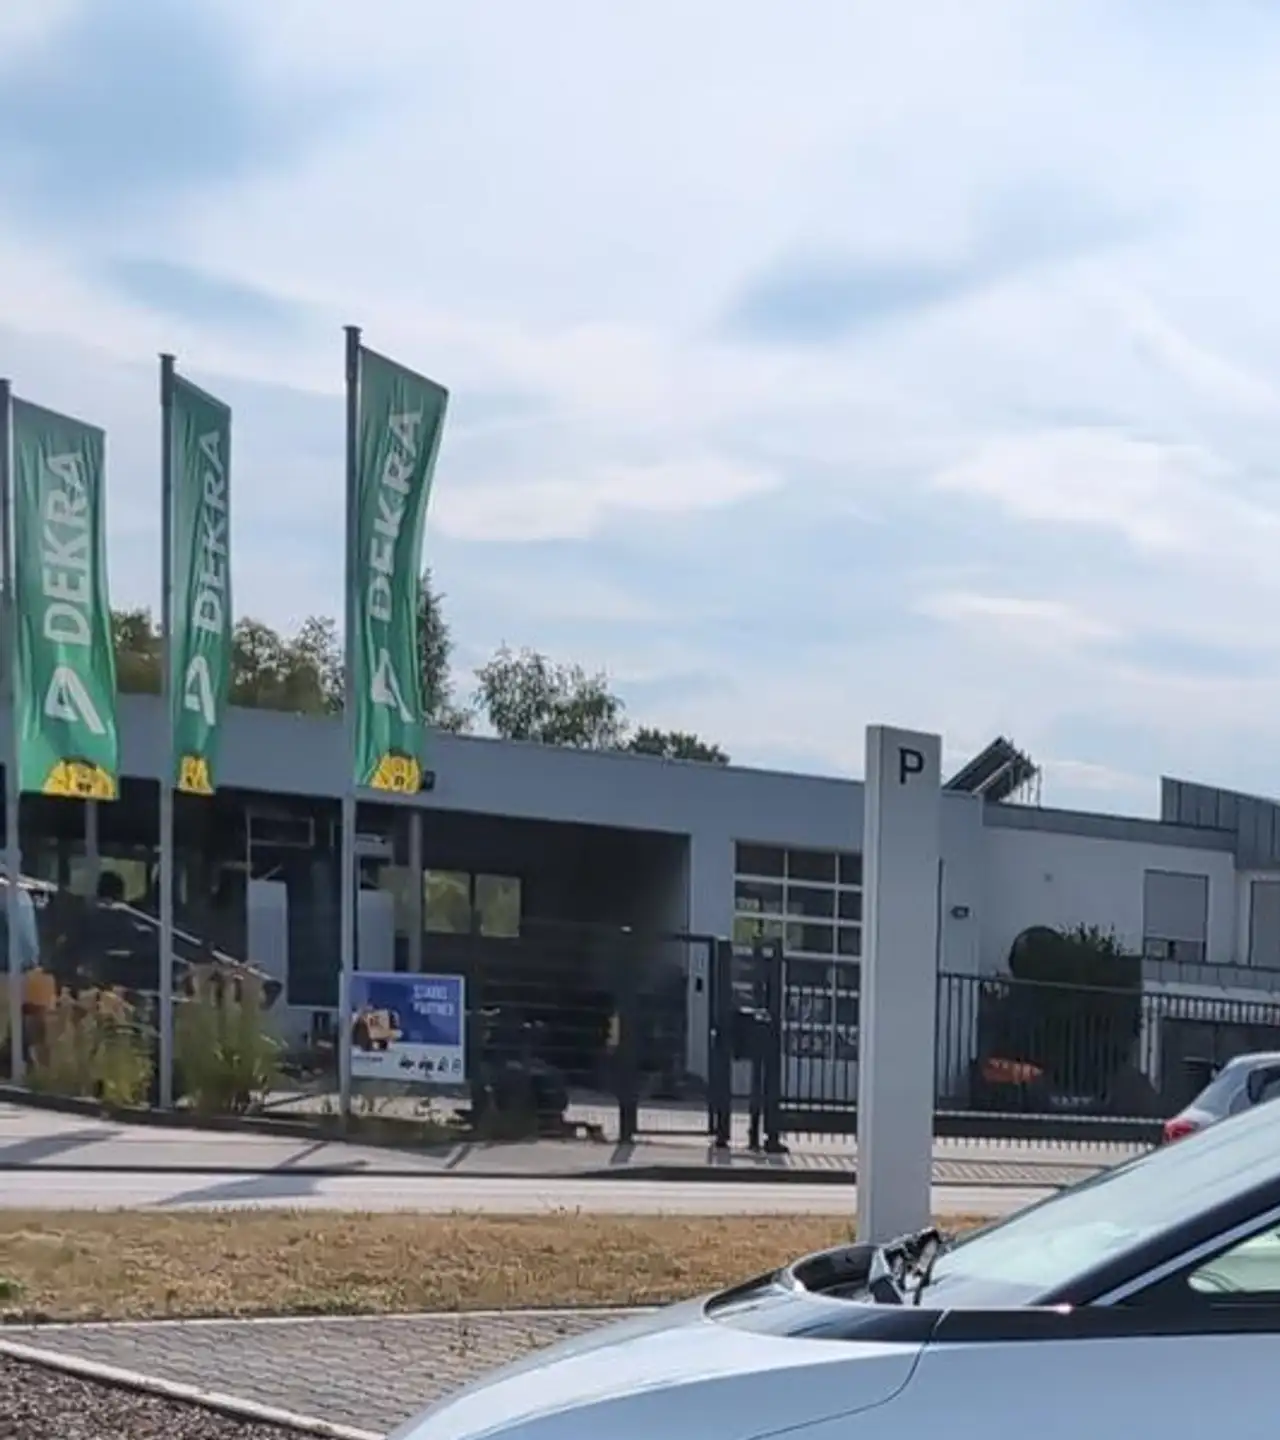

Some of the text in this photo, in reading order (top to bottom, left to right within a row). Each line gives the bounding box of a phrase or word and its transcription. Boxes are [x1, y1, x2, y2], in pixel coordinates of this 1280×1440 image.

[43, 452, 93, 646] DEKRA
[191, 430, 228, 635] DEKRA
[367, 411, 423, 622] DEKRA
[899, 746, 924, 785] P
